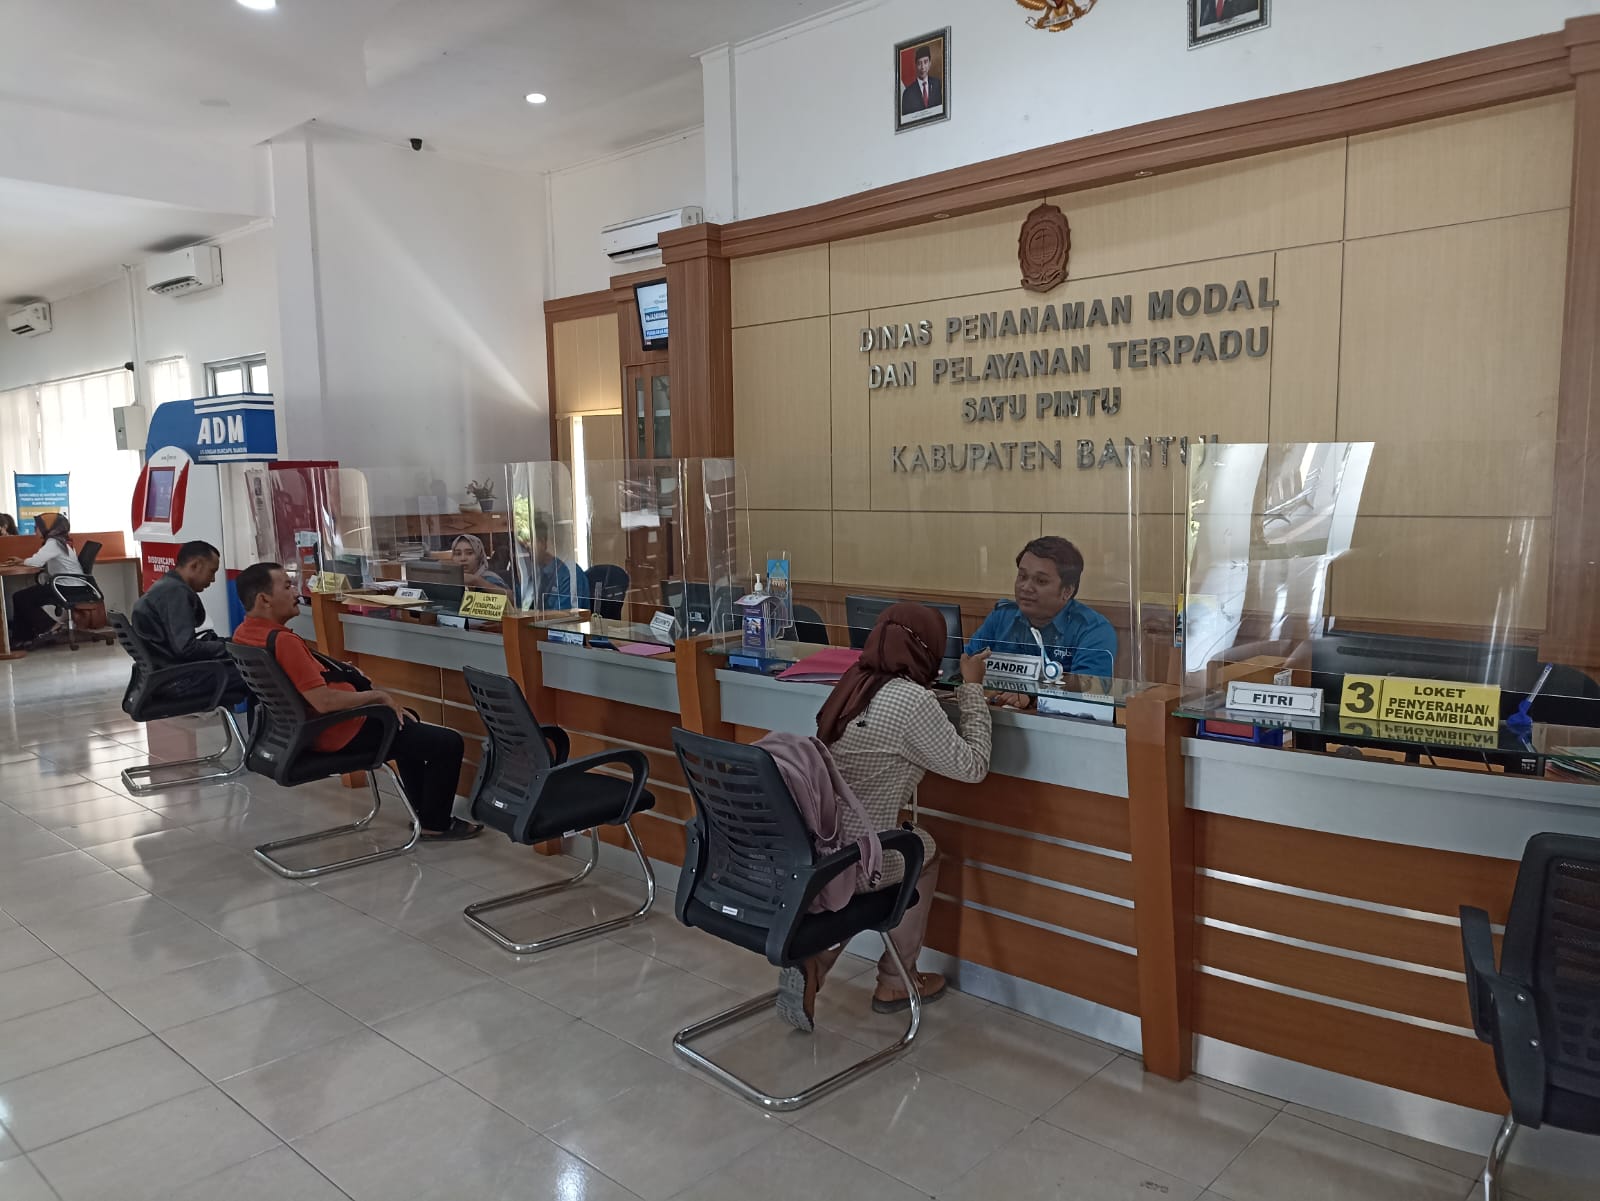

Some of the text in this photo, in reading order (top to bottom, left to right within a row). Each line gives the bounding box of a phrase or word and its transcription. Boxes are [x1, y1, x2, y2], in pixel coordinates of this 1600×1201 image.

[859, 277, 1279, 353] DINAS PENANAMAN MODAL
[867, 326, 1269, 389] DAN PELAYANAN TERPADU
[961, 387, 1121, 424] SATU PINTU
[197, 415, 245, 445] ADM
[892, 440, 1062, 473] KABUPATEN
[462, 595, 474, 612] 2
[987, 660, 1028, 674] PANDRI
[1252, 693, 1293, 707] FITRI
[1345, 681, 1375, 714] 3
[1414, 686, 1466, 699] LOKET
[1384, 708, 1495, 728] PENGAMBILAN
[1389, 697, 1490, 714] PENYERAHAN/
